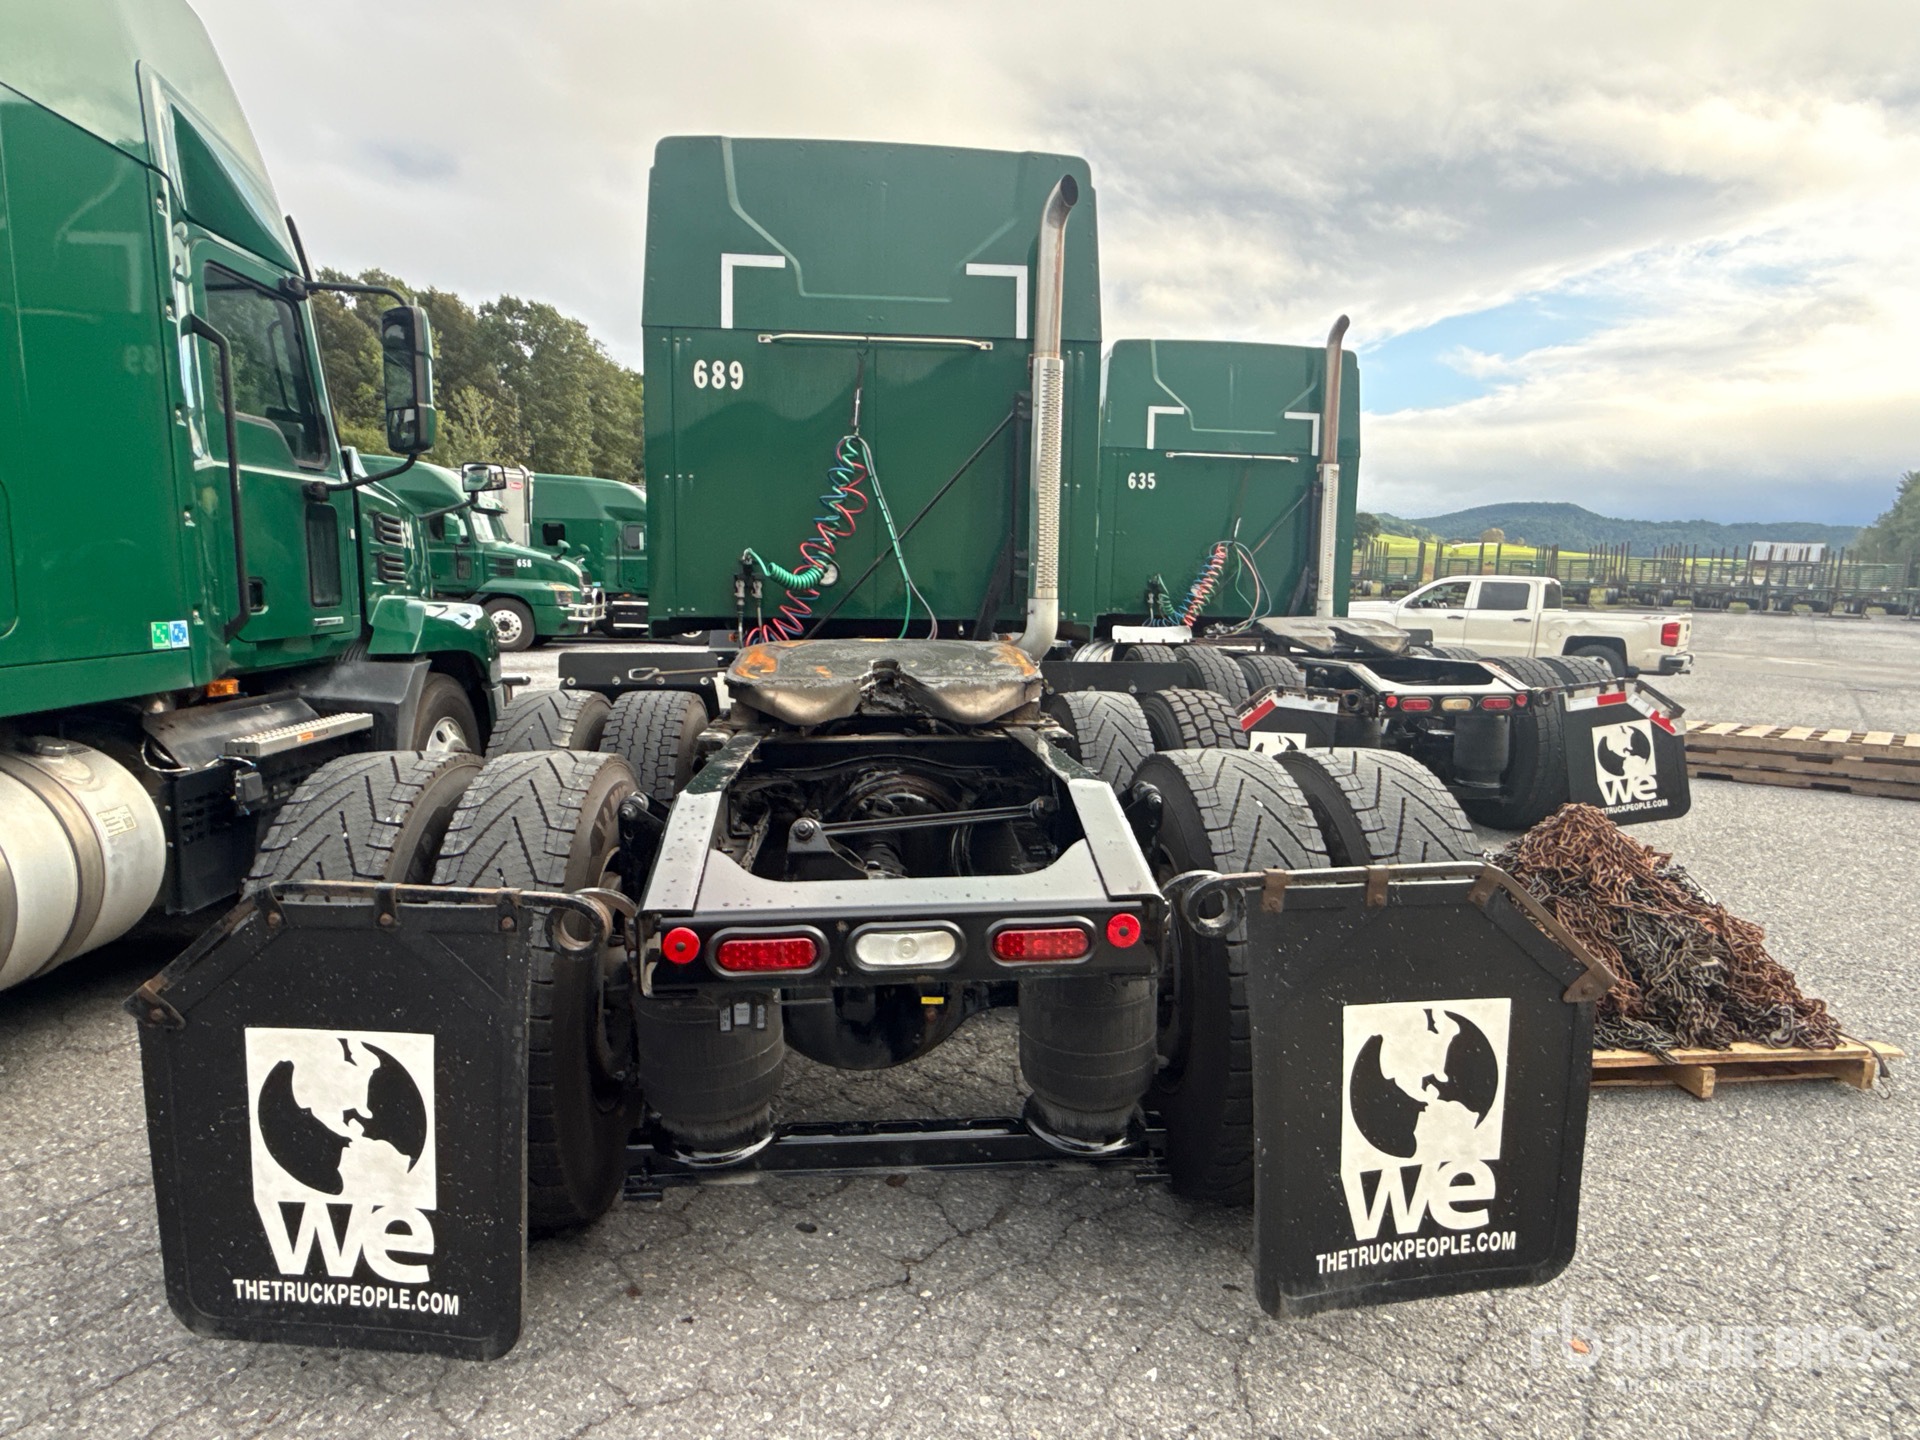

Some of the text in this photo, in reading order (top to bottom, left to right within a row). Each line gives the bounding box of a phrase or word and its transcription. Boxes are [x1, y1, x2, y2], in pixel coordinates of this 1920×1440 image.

[693, 359, 744, 390] 689
[1127, 471, 1156, 490] 635
[516, 558, 532, 568] 658
[1315, 1231, 1517, 1275] THETRUCKPEOPLE.COM
[232, 1278, 460, 1316] THETRUCKPEOPLE.COM
